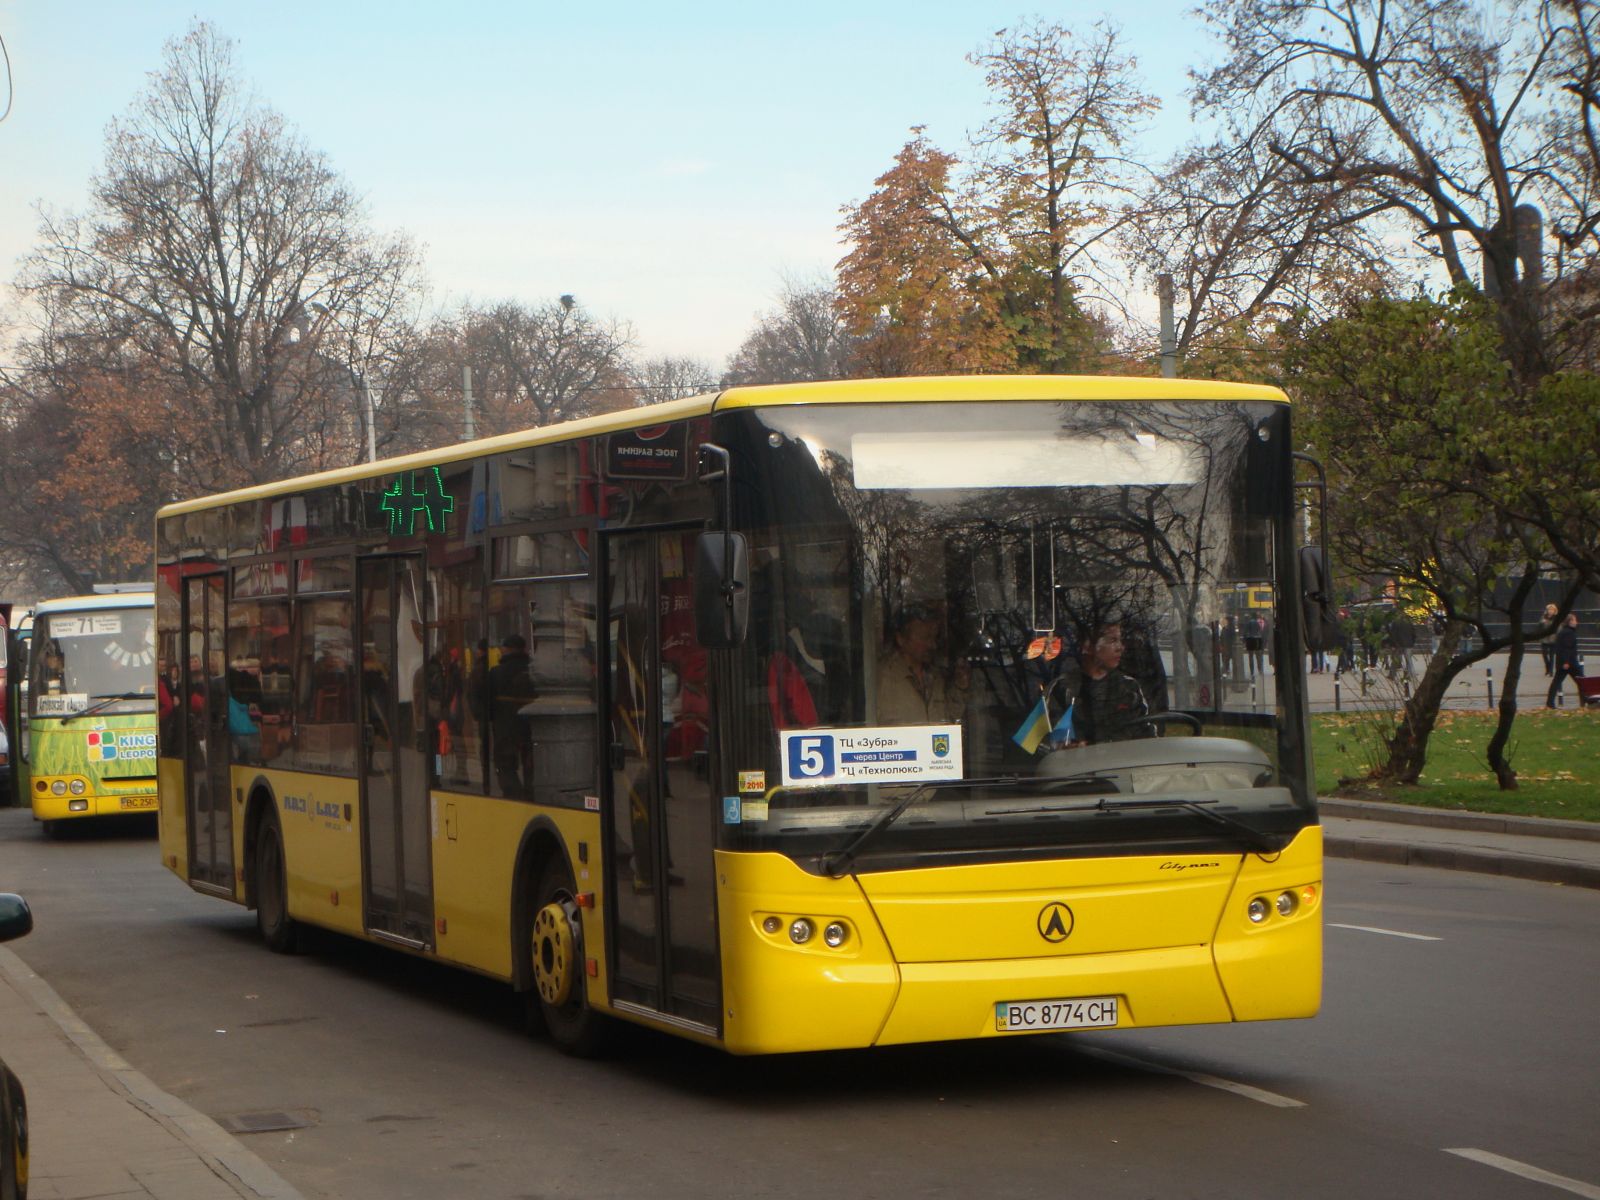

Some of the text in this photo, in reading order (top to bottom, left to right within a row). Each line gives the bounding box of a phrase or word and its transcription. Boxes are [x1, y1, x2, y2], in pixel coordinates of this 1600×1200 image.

[77, 617, 94, 634] 71
[120, 735, 155, 747] KING
[839, 737, 899, 749] ТЦ «Зубра»
[120, 748, 157, 758] LEOPO
[799, 738, 824, 776] 5
[853, 751, 904, 763] через Центр
[841, 765, 923, 777] ТЦ «Технолюкс»
[747, 781, 764, 790] 2010
[1009, 1001, 1114, 1026] BC 8774 CH
